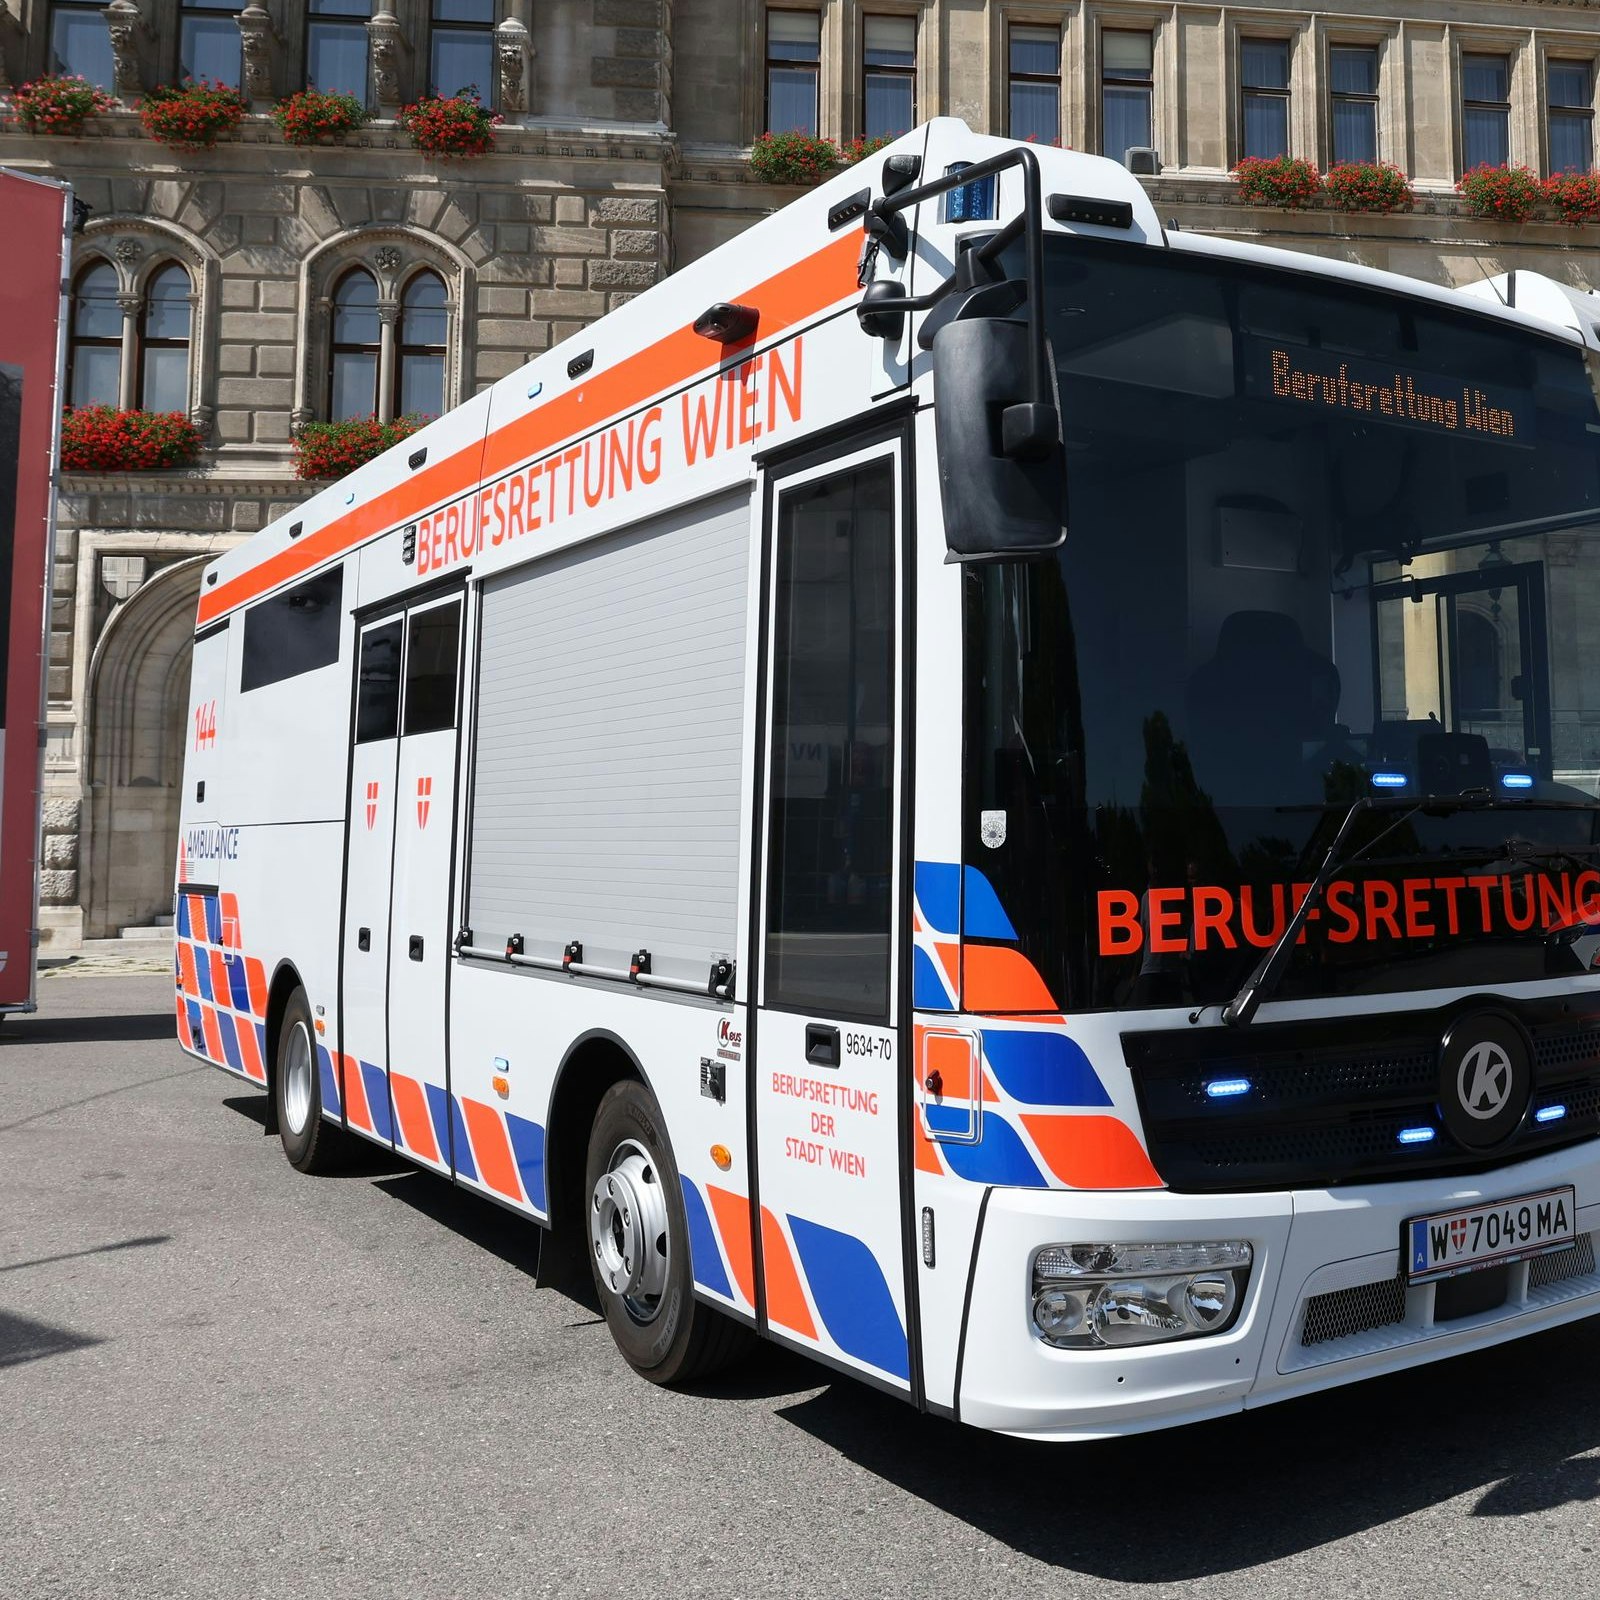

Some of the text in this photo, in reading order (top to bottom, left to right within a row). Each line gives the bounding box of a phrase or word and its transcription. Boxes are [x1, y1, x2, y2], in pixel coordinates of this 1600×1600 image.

[1271, 350, 1514, 436] Berufsrettung Wien
[417, 336, 802, 576] BERUFSRETTUNG WIEN
[195, 700, 216, 752] 144
[187, 829, 239, 860] AMBULANCE
[846, 1033, 892, 1060] 9634-70
[772, 1072, 878, 1115] BERUFSRETTUNG
[811, 1112, 835, 1137] DER
[785, 1137, 865, 1178] STADT WIEN
